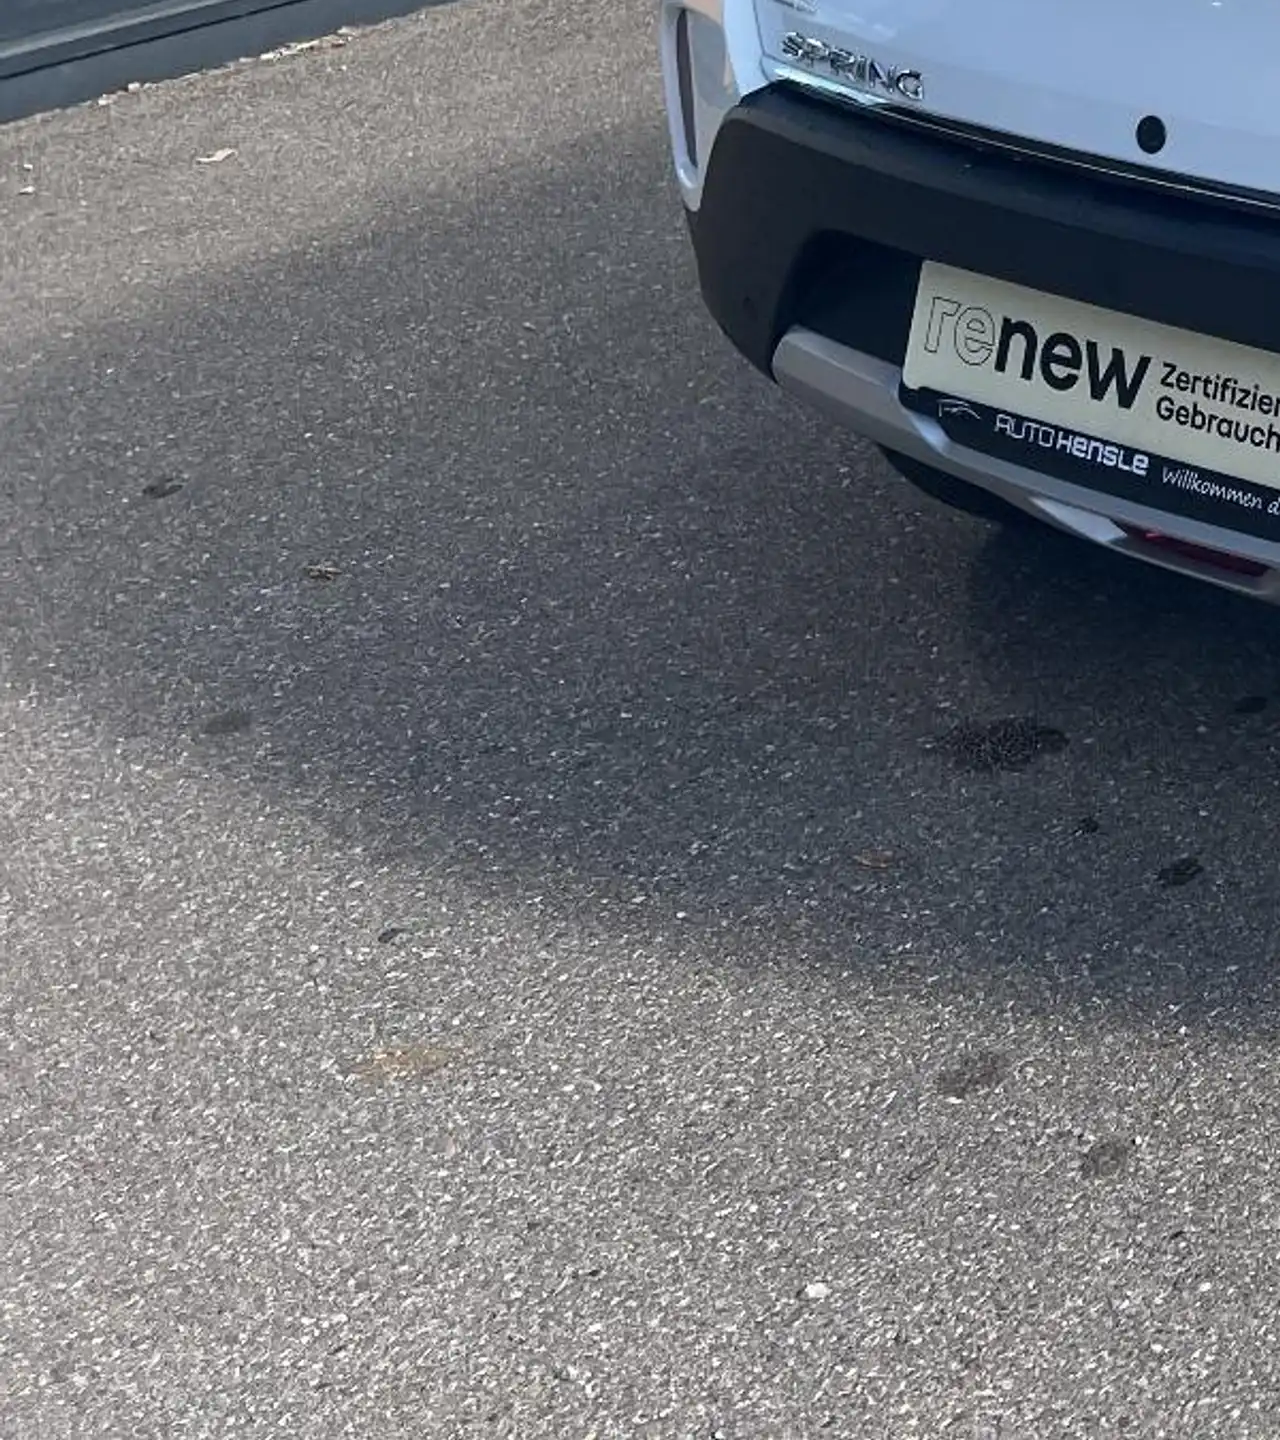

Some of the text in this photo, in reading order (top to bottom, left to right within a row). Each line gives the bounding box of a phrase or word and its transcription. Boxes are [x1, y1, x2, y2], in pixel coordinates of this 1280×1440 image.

[782, 32, 924, 101] SPRING
[924, 296, 1152, 409] renew
[1161, 465, 1263, 509] Willkommen
